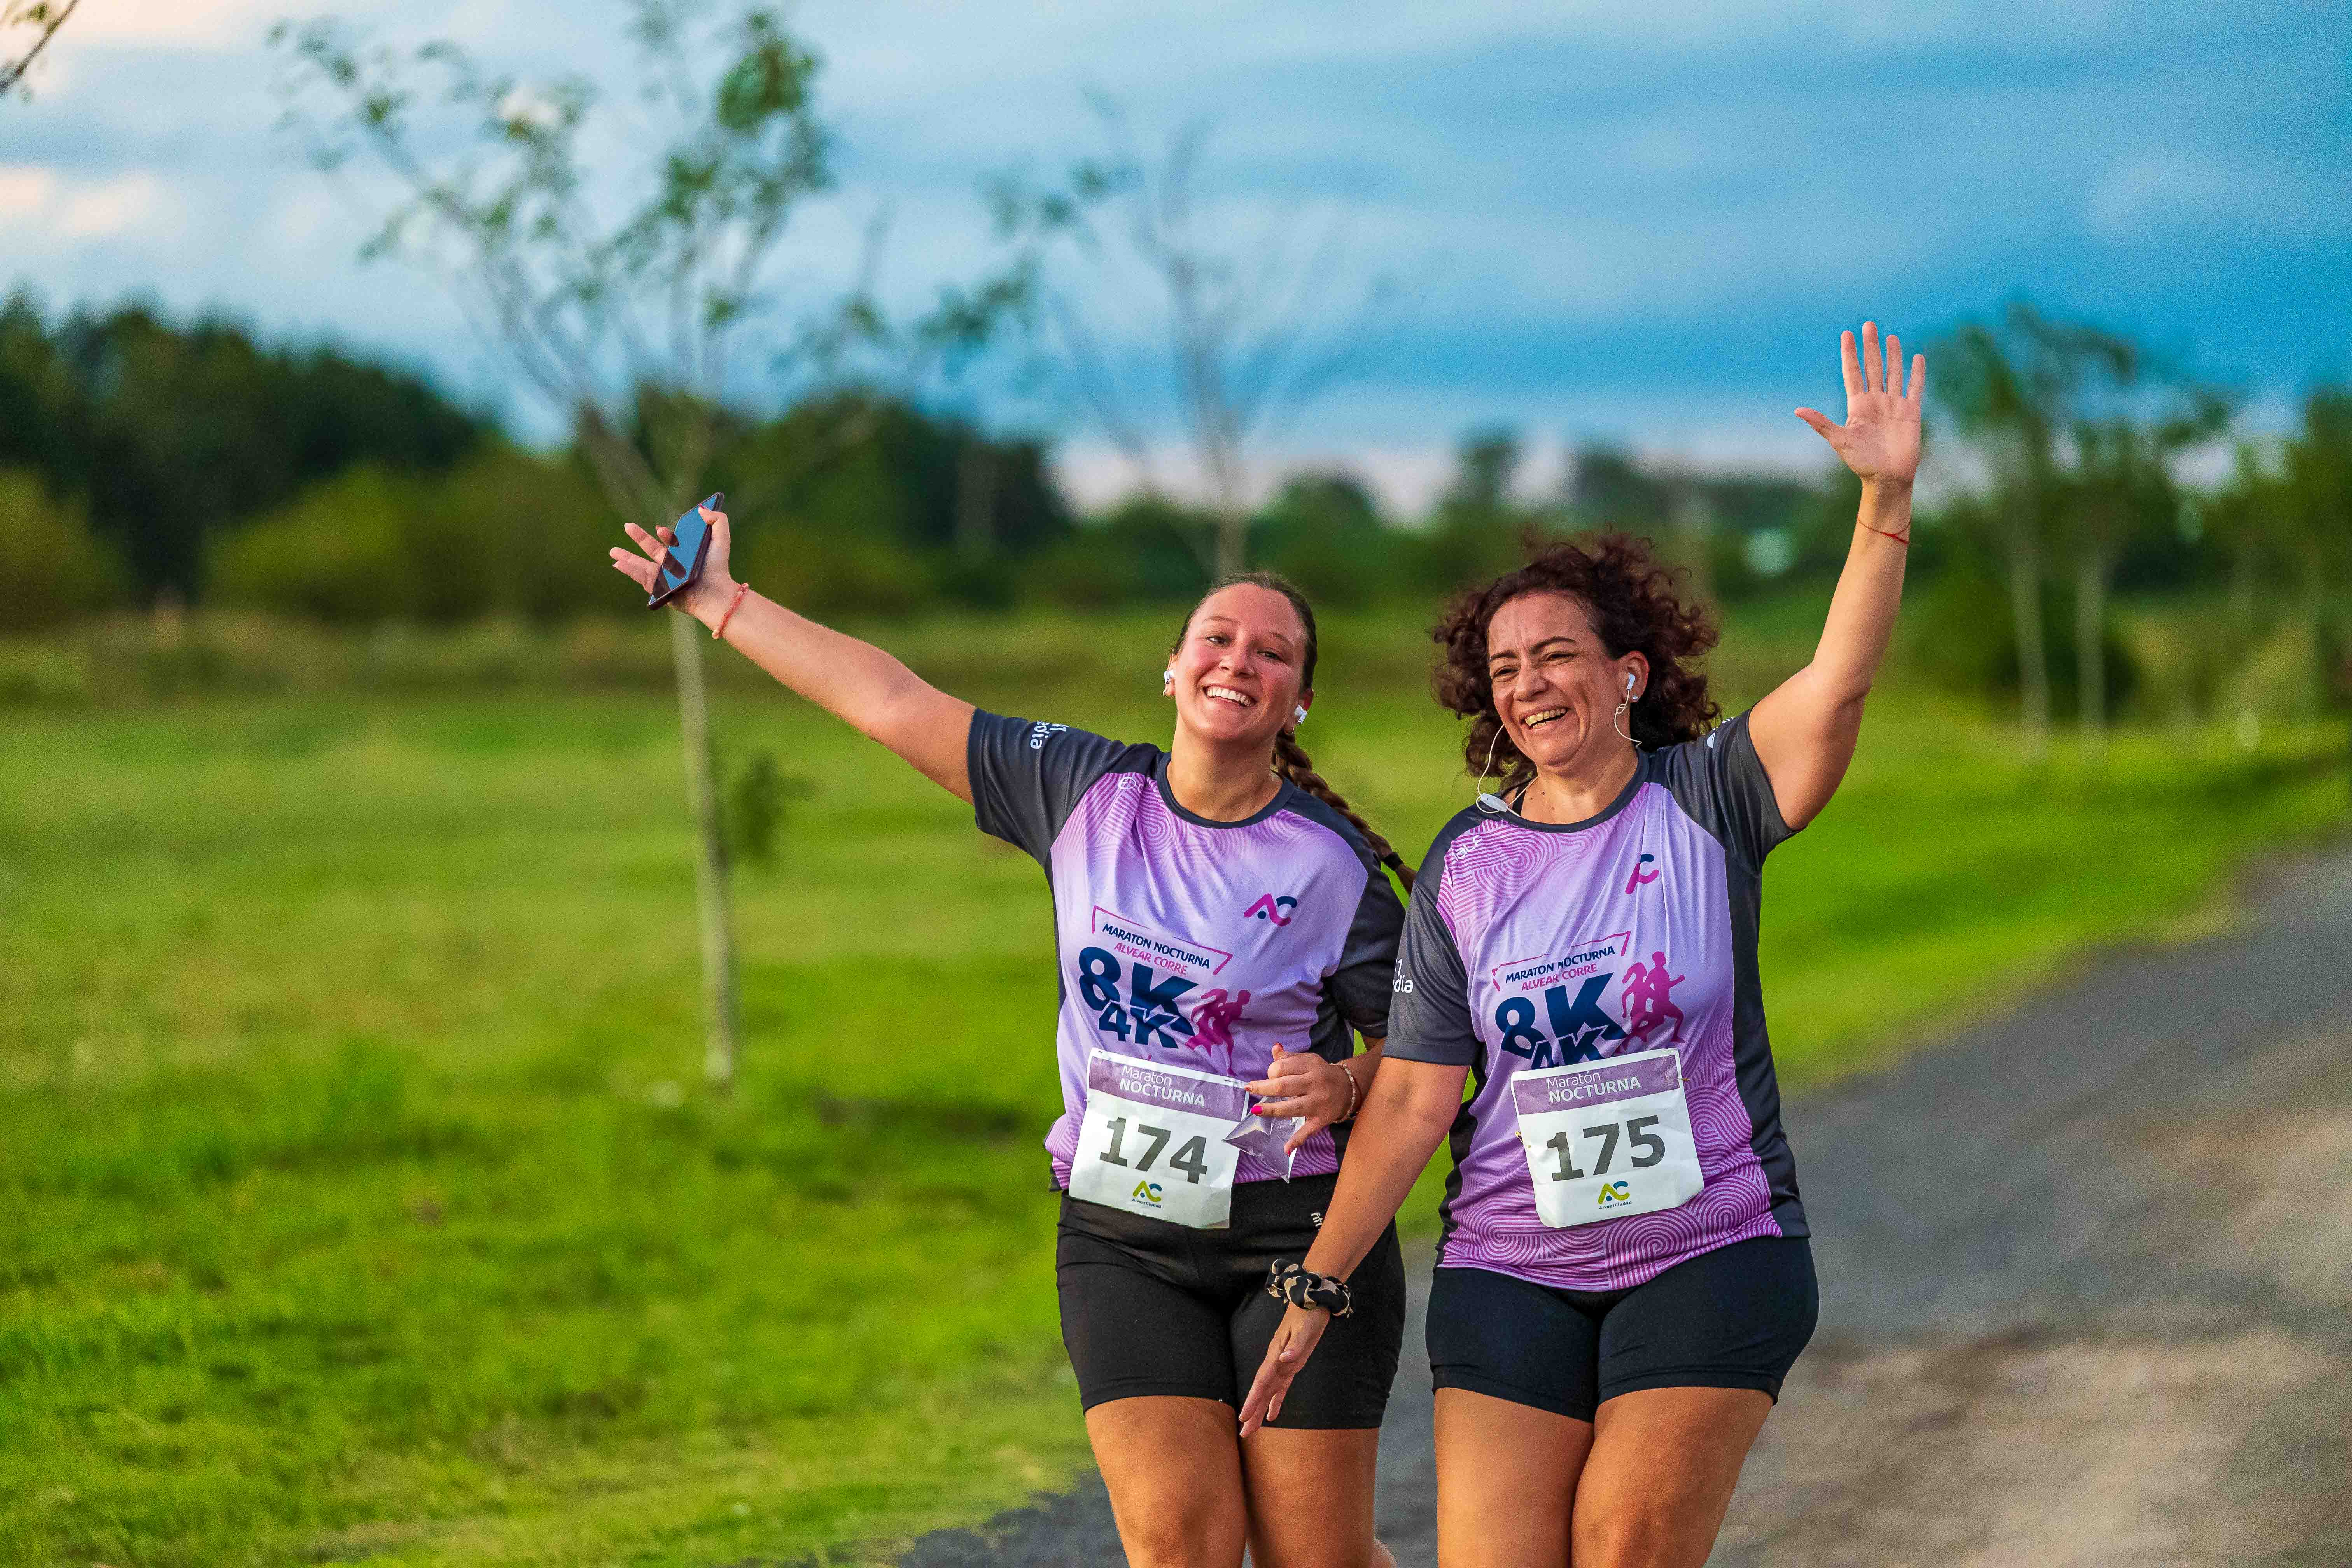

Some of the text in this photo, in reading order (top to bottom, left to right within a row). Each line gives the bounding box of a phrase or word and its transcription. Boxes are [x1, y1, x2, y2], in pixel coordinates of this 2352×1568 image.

[1102, 924, 1210, 969] MARATON NOCTURNA
[1114, 942, 1188, 975] ALVEAR CORRE
[1505, 946, 1615, 983] MARATON NOCTURNA
[1522, 963, 1598, 992] ALVEAR CORRE
[1079, 946, 1199, 1036] 8K
[1393, 975, 1414, 993] dia
[1099, 1001, 1179, 1049] 4K
[1495, 972, 1628, 1060] 8K
[1119, 1078, 1205, 1107] NOCTURNA
[1122, 1065, 1171, 1087] Maratón
[1547, 1071, 1601, 1089] Maratón
[1549, 1076, 1642, 1103] NOCTURNA
[1099, 1116, 1208, 1184] 174
[1546, 1115, 1665, 1181] 175
[1599, 1200, 1632, 1210] AlvearCiudad
